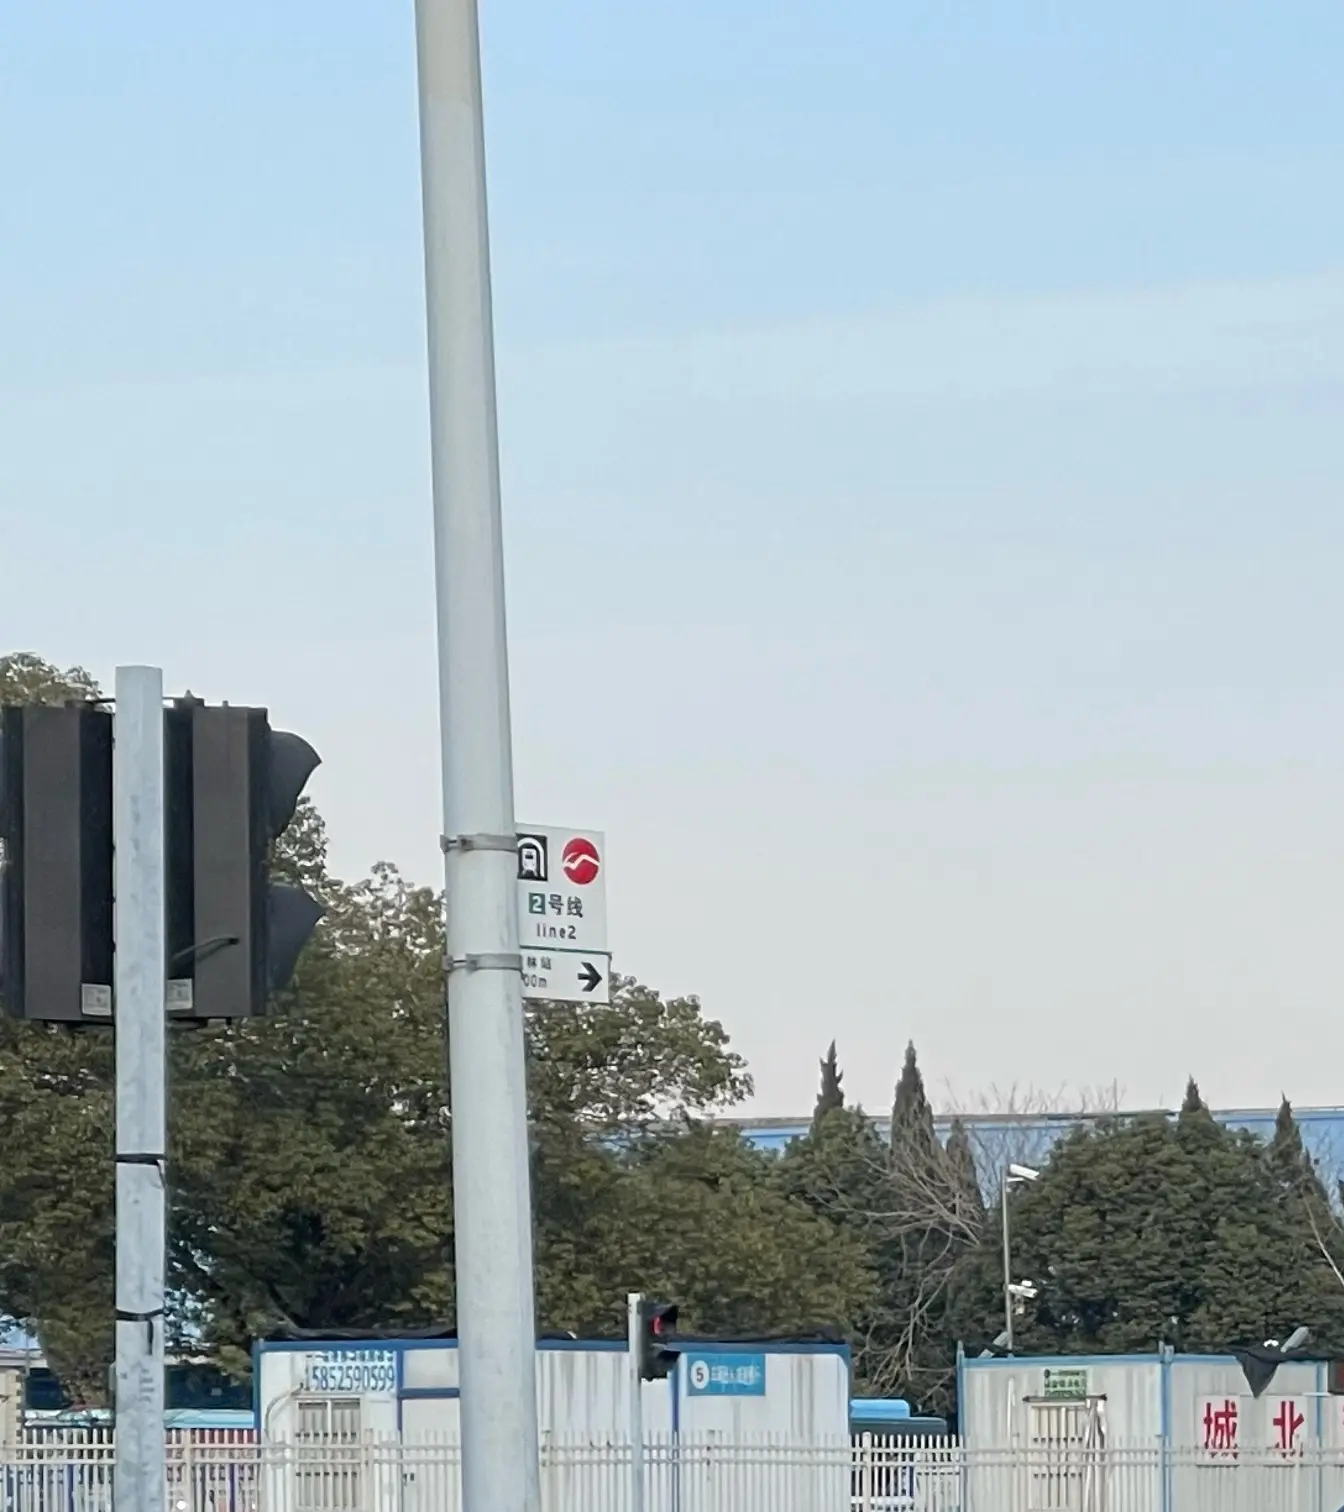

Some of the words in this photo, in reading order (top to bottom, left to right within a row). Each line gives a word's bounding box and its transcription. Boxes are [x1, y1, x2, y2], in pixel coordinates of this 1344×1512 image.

[528, 892, 583, 918] 2号线
[536, 922, 576, 940] line2
[696, 1367, 704, 1383] 5
